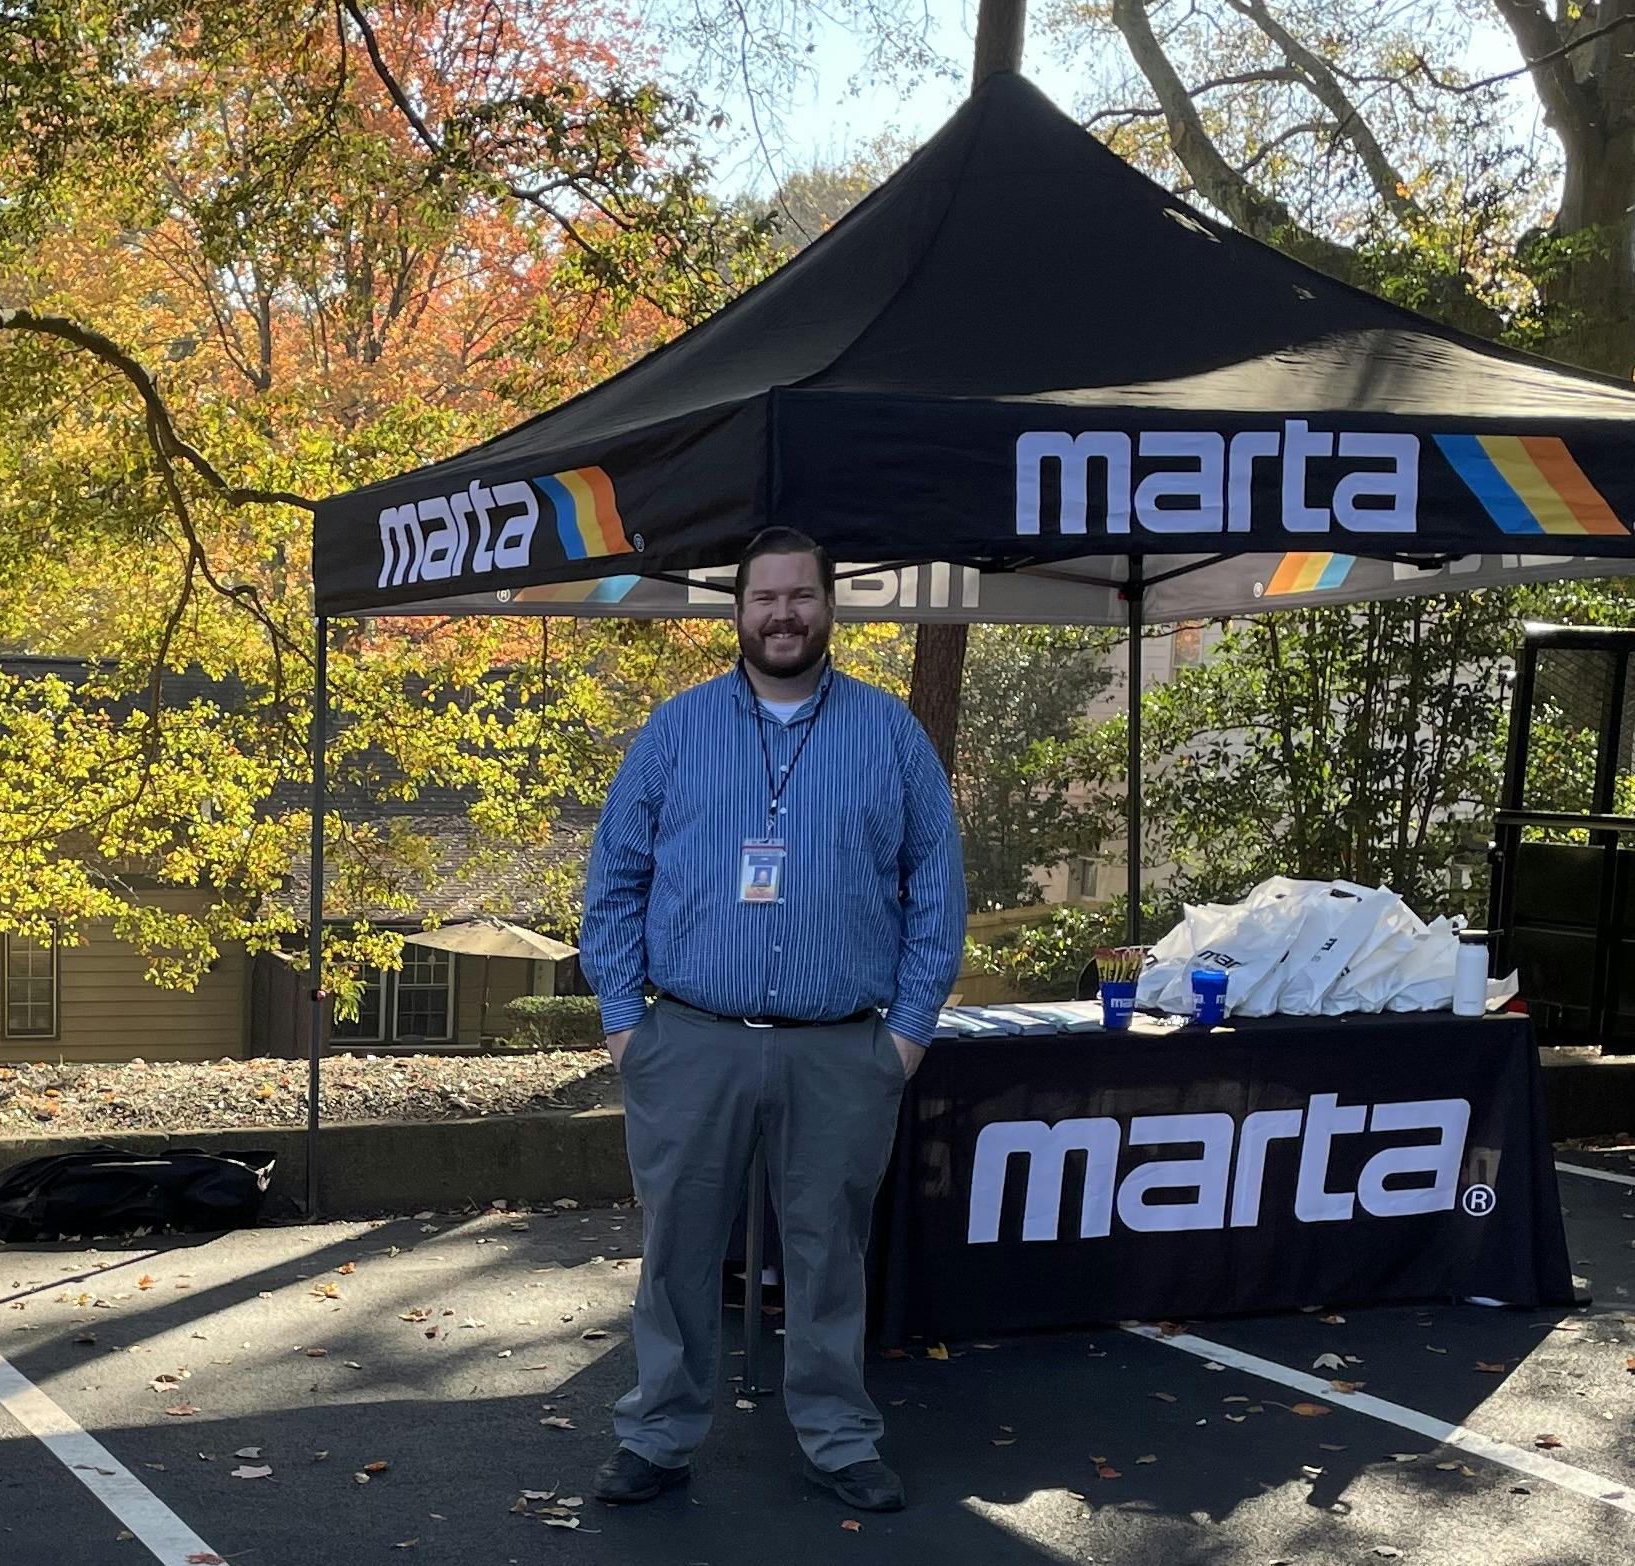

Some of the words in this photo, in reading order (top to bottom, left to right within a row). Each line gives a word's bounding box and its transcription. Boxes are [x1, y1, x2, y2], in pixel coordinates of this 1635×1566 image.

[1016, 419, 1421, 535] marta
[377, 479, 539, 589] marta
[1197, 950, 1243, 969] mar
[967, 1092, 1472, 1244] marta
